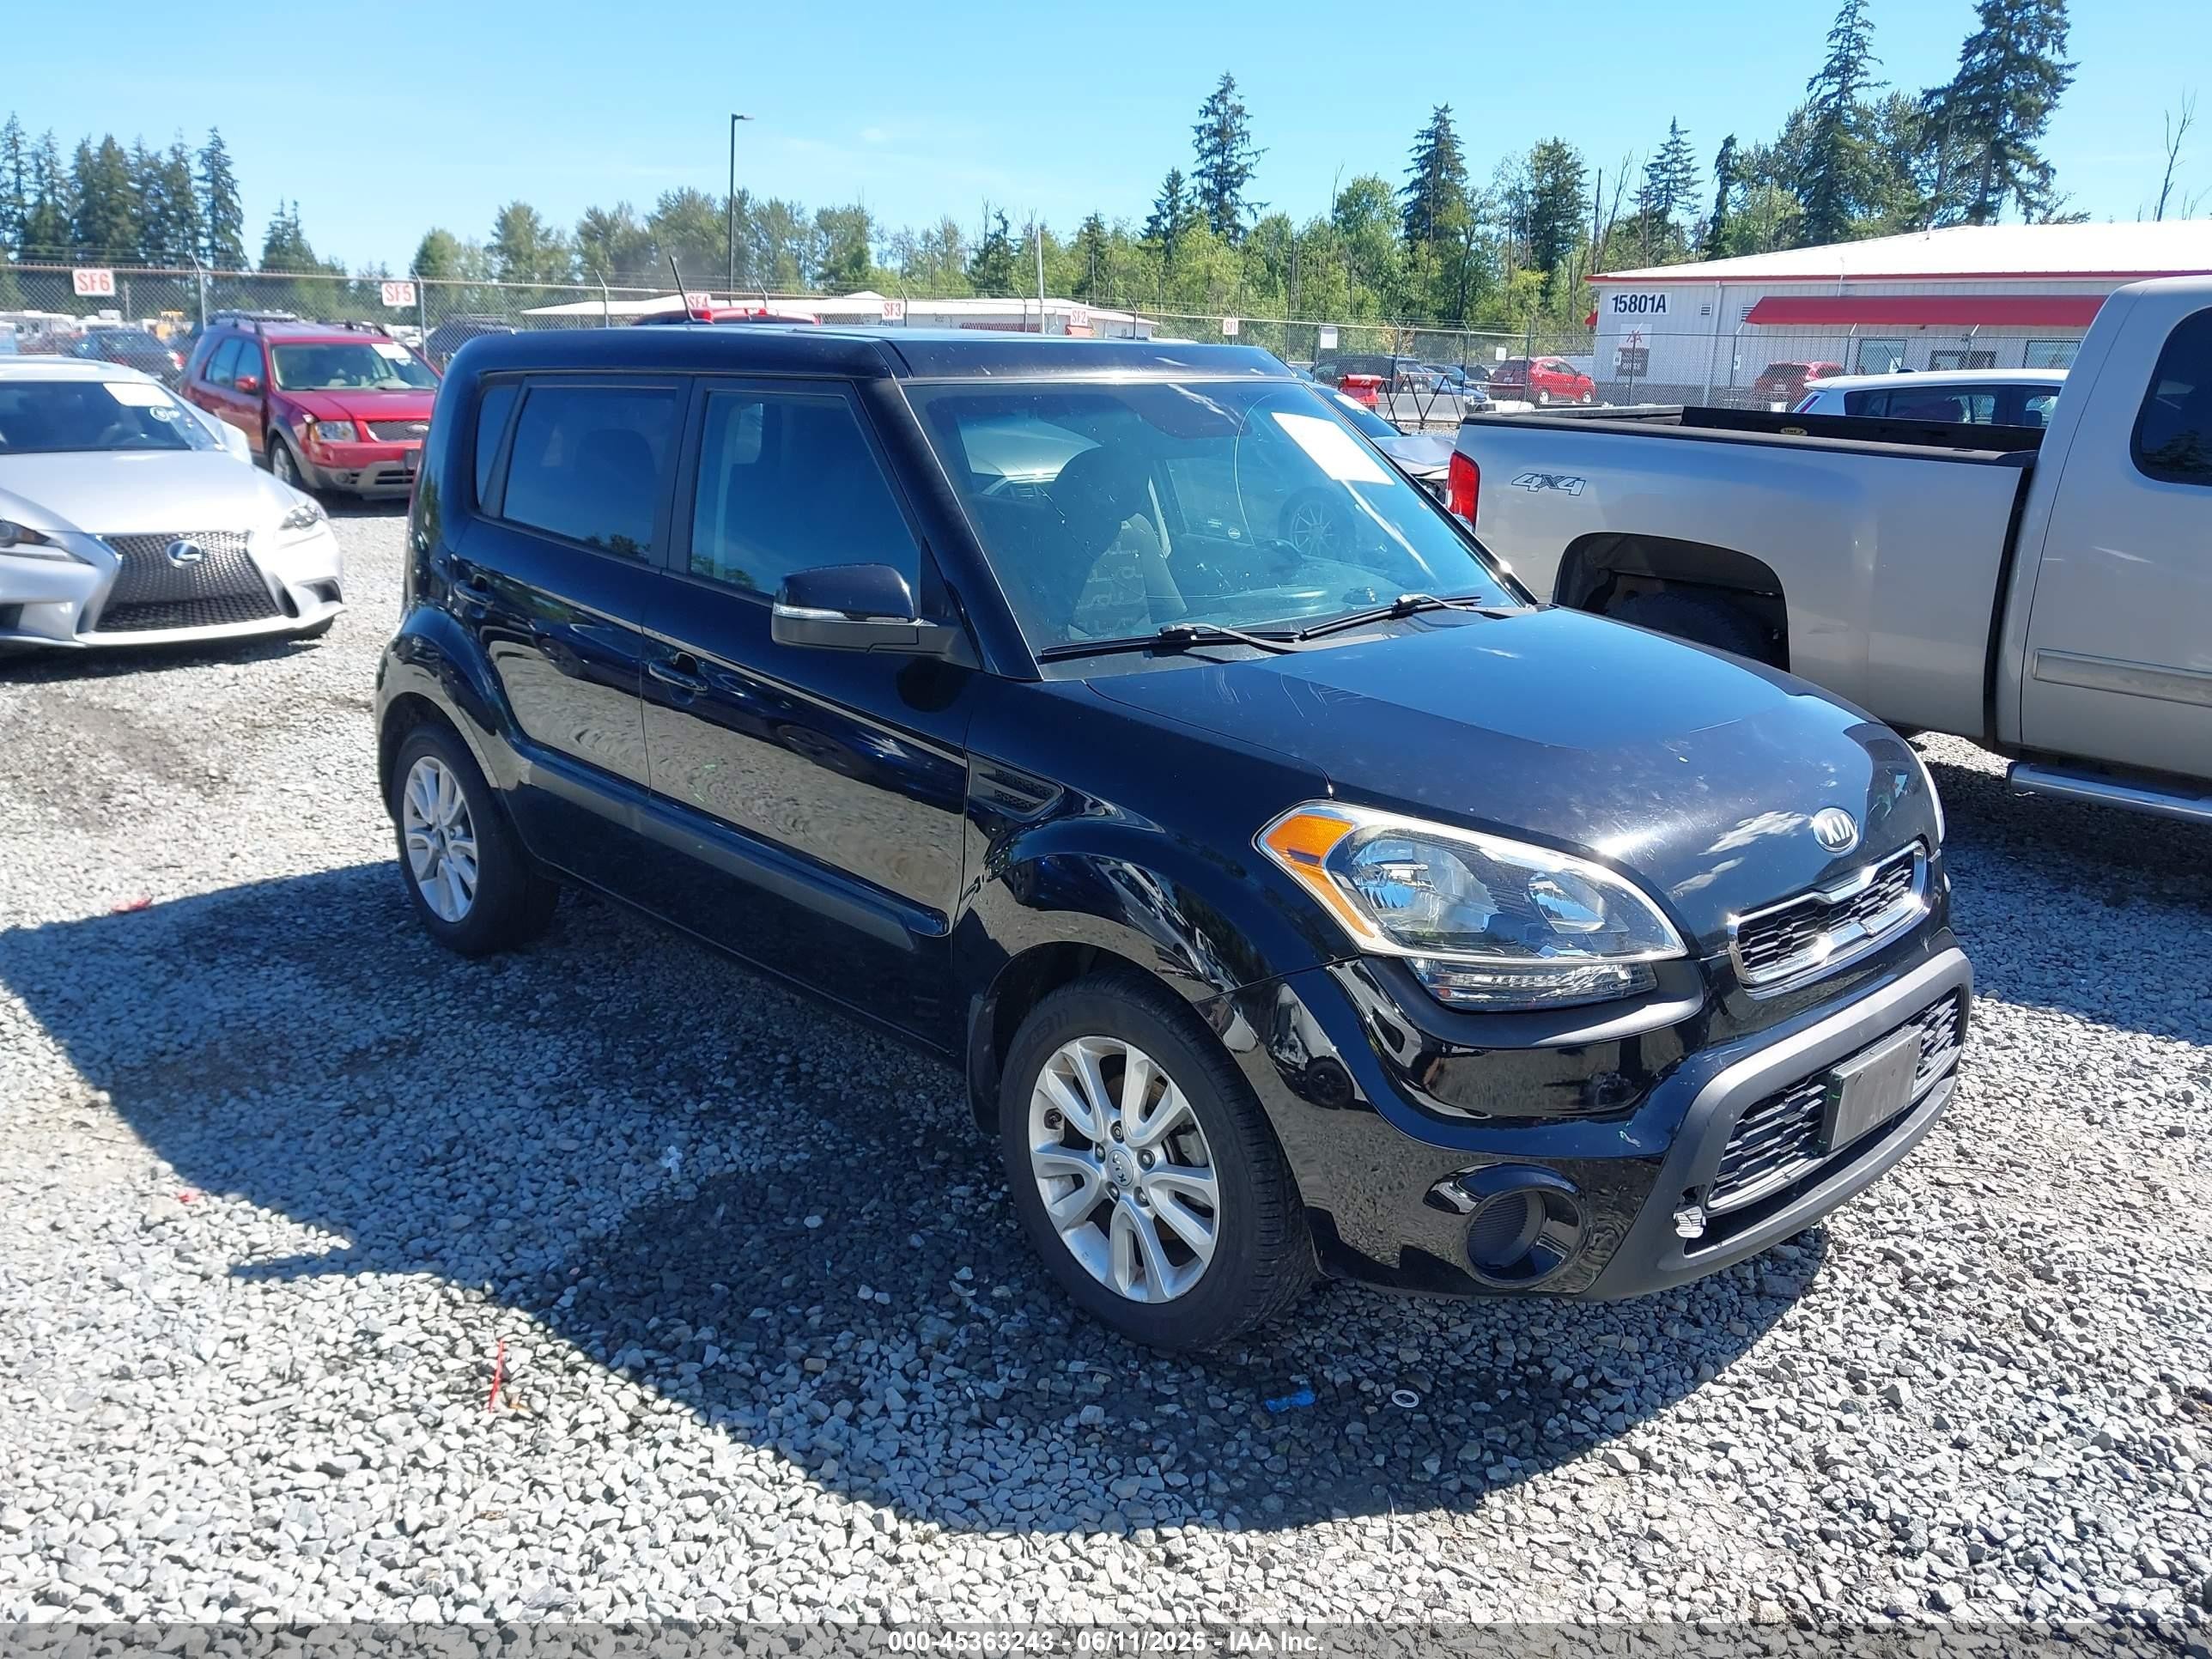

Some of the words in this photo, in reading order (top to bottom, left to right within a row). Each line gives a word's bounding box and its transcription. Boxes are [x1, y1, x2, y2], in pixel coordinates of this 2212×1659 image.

[77, 272, 110, 291] SF6
[386, 284, 412, 301] SF5
[884, 302, 901, 317] SF3
[1612, 294, 1667, 313] 15801A
[1073, 310, 1086, 324] SF2
[1225, 321, 1237, 333] SF1
